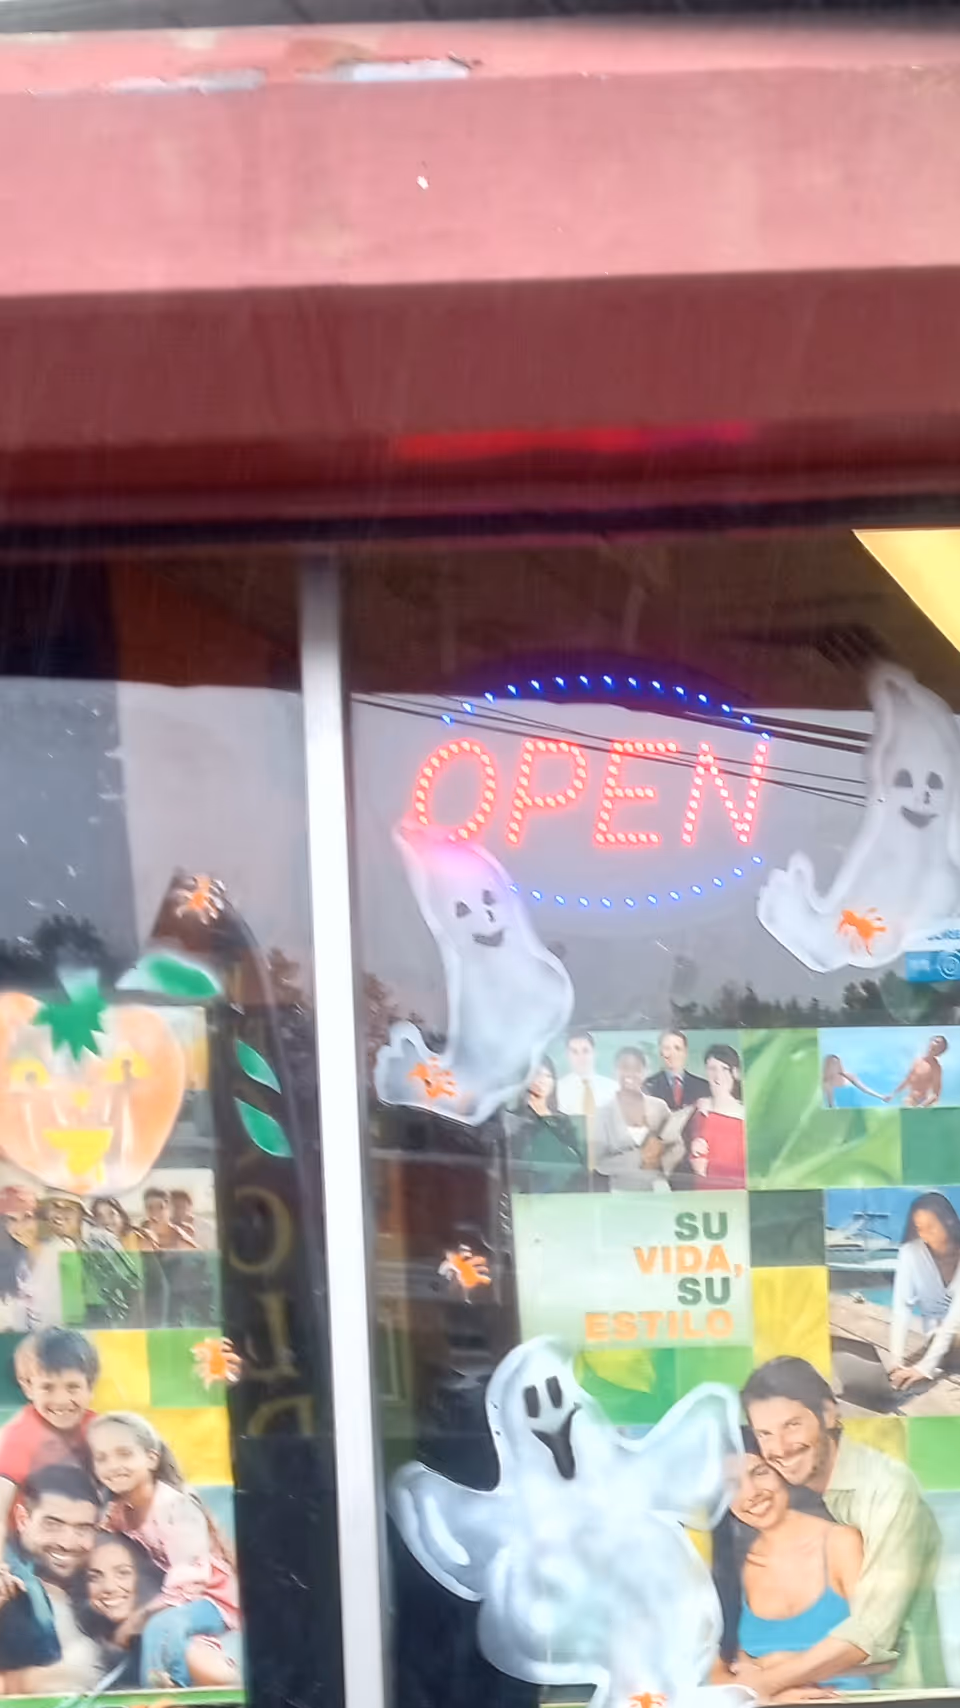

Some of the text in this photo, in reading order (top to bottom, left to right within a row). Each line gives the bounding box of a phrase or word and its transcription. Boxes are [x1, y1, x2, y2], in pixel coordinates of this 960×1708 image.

[412, 738, 769, 846] OPEN
[674, 1211, 728, 1241] SU
[634, 1245, 743, 1278] VIDA,
[677, 1277, 731, 1306] SU
[584, 1309, 734, 1342] ESTILO
